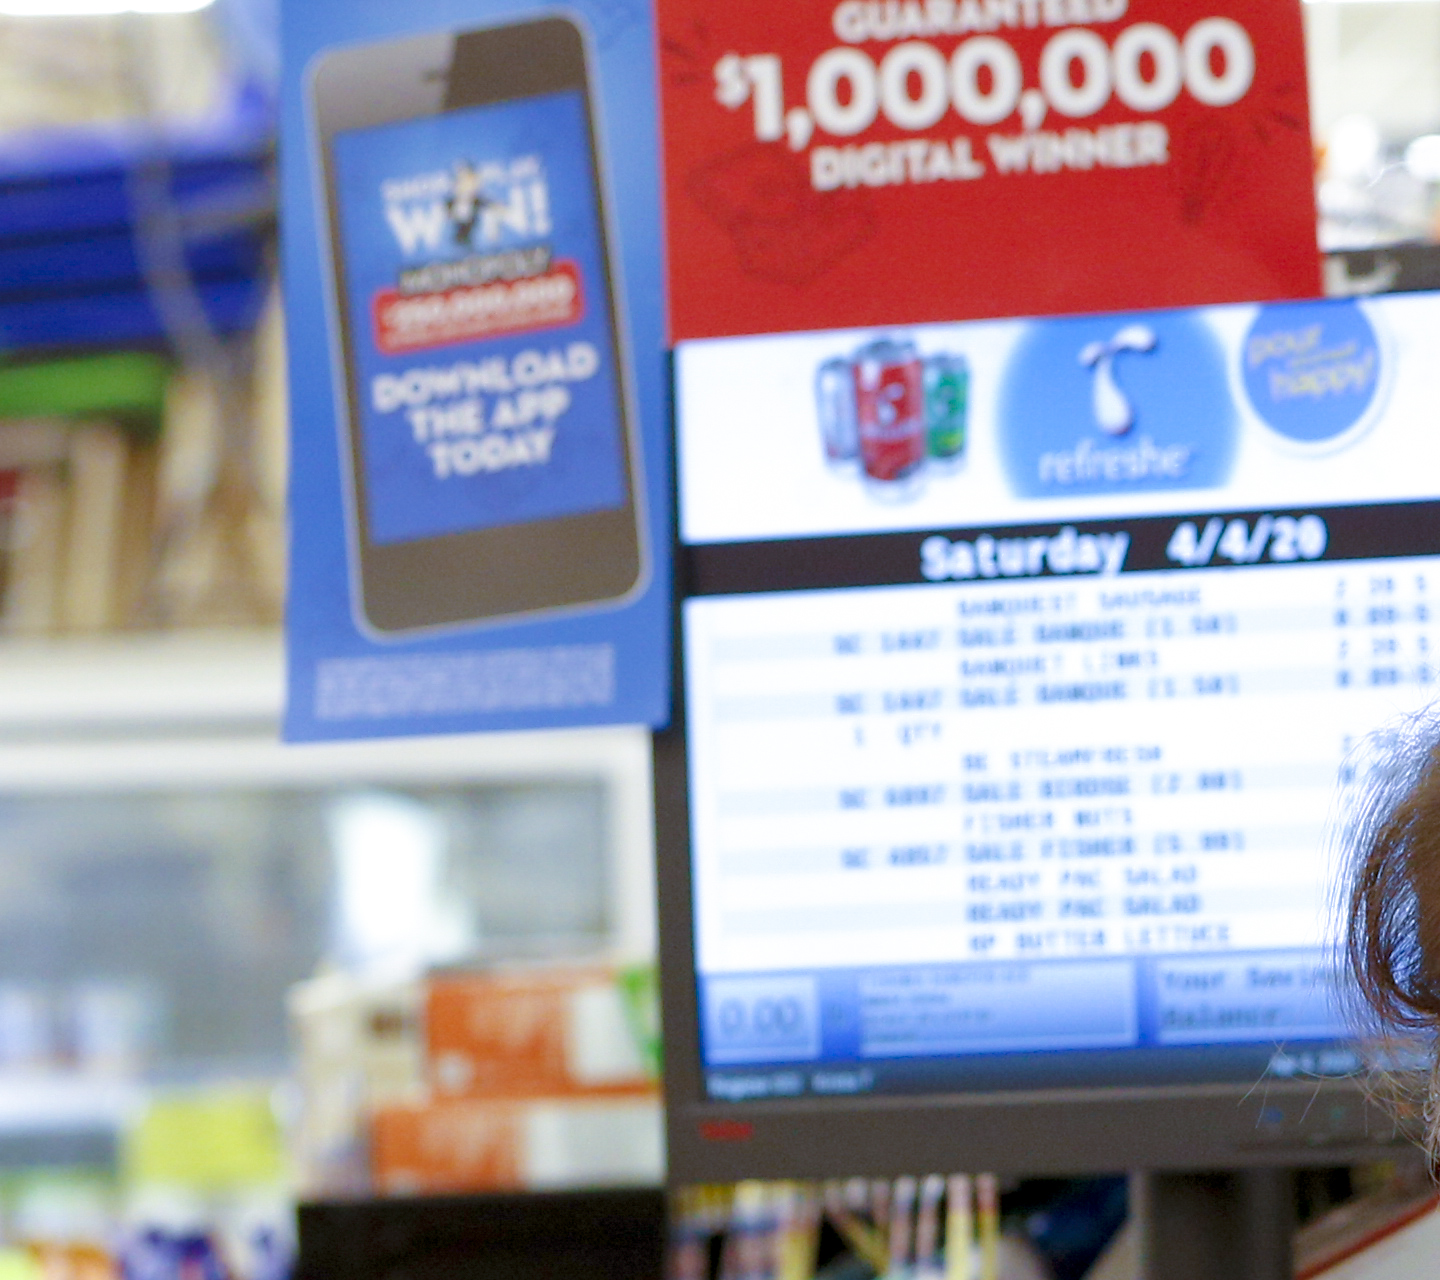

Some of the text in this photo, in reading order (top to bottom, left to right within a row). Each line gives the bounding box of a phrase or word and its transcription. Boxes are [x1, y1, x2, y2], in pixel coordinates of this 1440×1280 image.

[713, 16, 1256, 151] $1,000,000
[810, 123, 1169, 192] DIGITAL WINNER
[371, 341, 600, 413] DOWNLOAD
[406, 385, 570, 442] THE APP
[427, 427, 556, 480] TODAY
[921, 515, 1328, 581] Saturday 4/4/20
